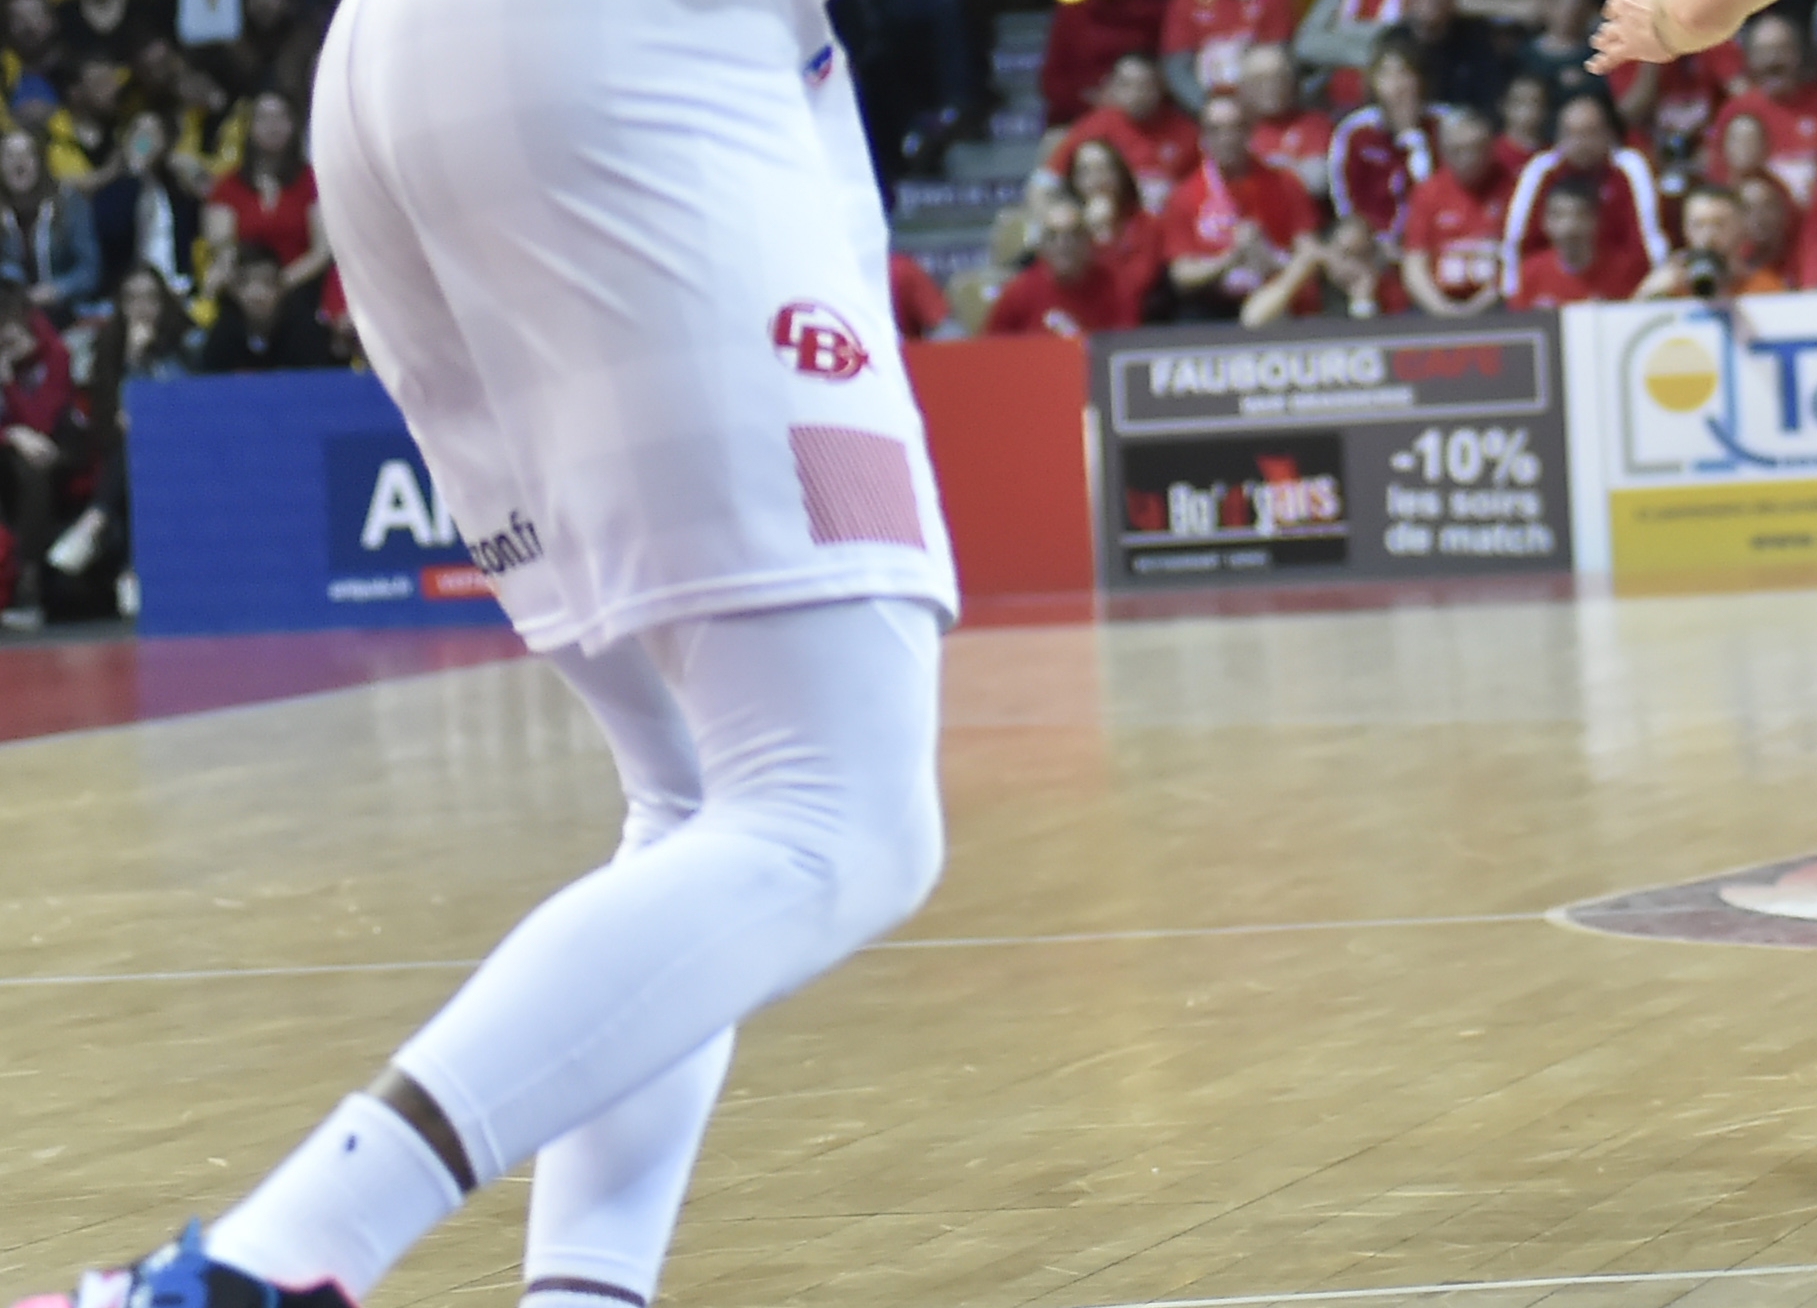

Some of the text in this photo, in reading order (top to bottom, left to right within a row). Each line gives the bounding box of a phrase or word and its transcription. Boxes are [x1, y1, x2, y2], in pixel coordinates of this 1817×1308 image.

[1150, 346, 1386, 397] FAUBOURG
[1389, 426, 1542, 491] -10%
[1386, 483, 1541, 521] les soirs
[1384, 520, 1555, 556] de match
